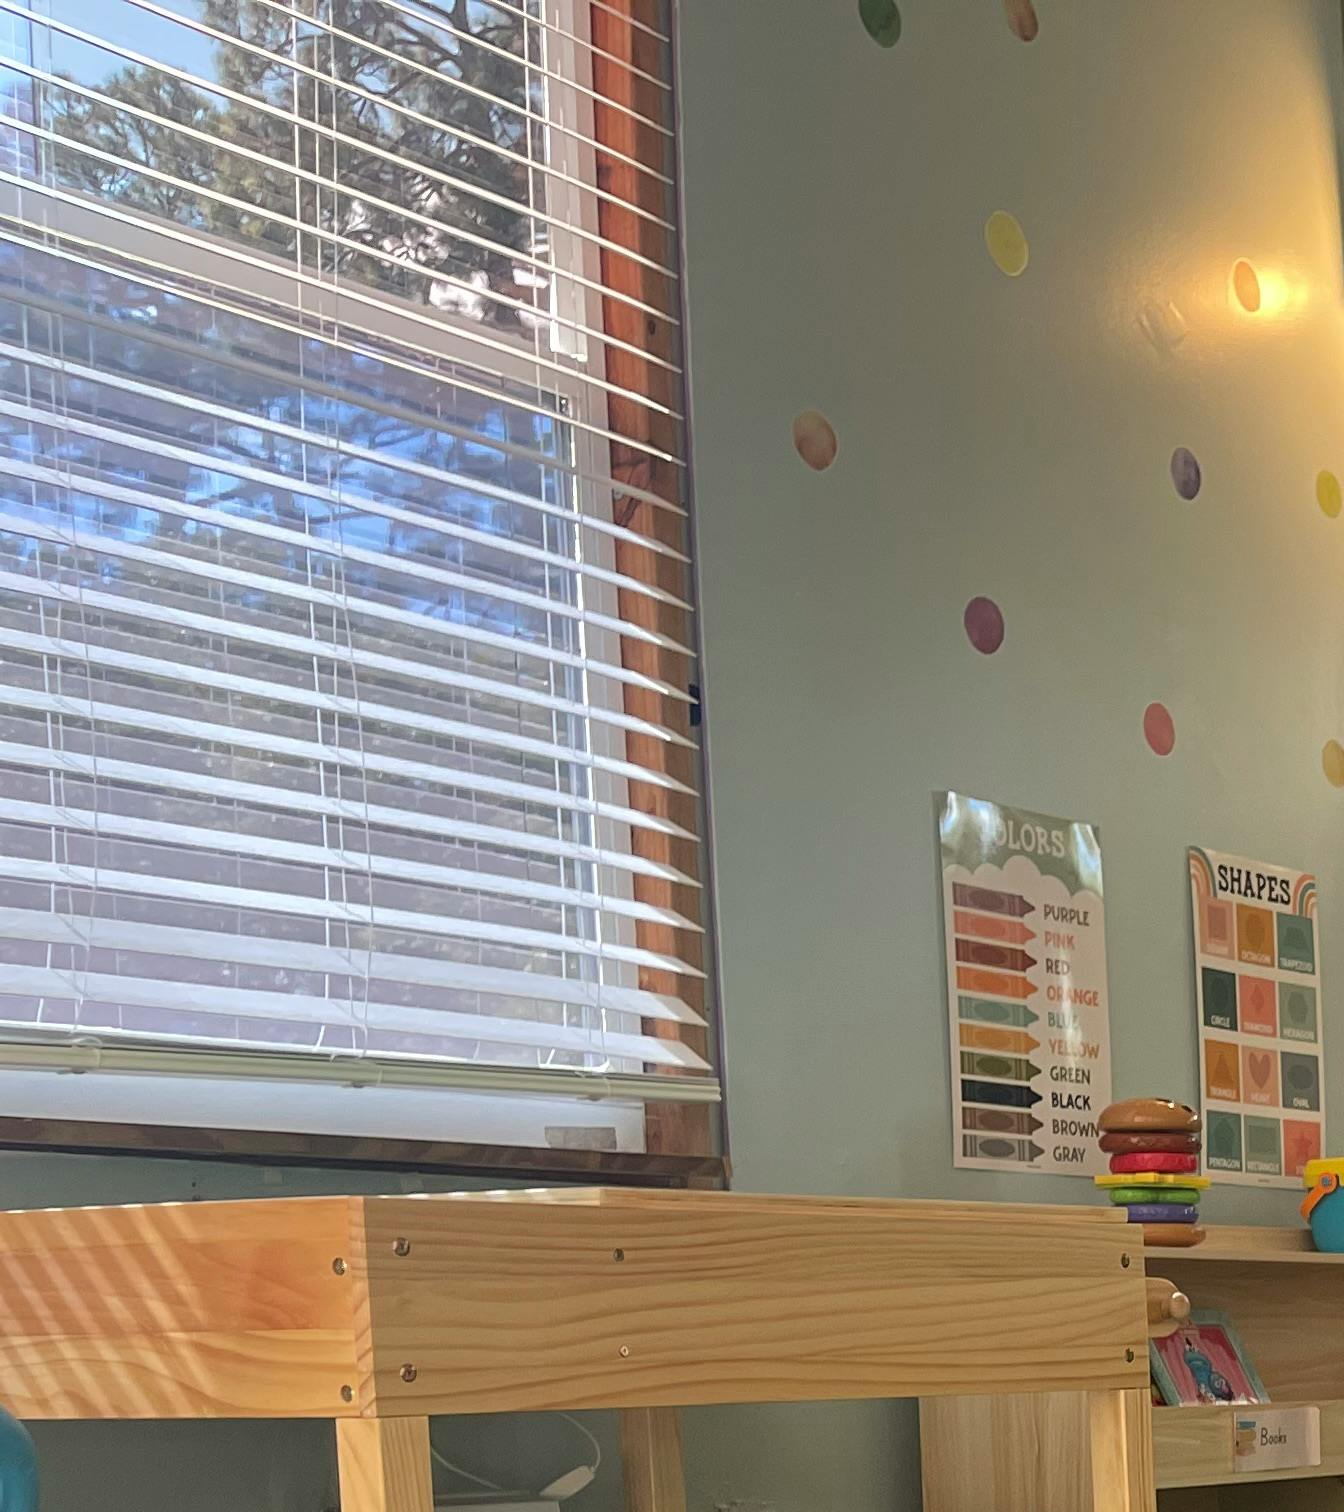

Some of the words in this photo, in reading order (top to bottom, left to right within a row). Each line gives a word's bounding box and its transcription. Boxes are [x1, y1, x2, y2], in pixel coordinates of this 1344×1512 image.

[992, 816, 1065, 859] OLORS
[1217, 864, 1291, 906] SHAPES
[1043, 903, 1090, 927] PURPLE
[1045, 931, 1076, 950] PINK
[1046, 958, 1070, 976] RED
[1047, 1011, 1079, 1029] BLUE
[1048, 1039, 1100, 1059] YELOW
[1050, 1065, 1091, 1085] GREEN
[1051, 1092, 1091, 1111] BLACK
[1052, 1119, 1100, 1138] BROWN
[1053, 1146, 1086, 1163] GRAY
[1260, 1425, 1287, 1446] Books
